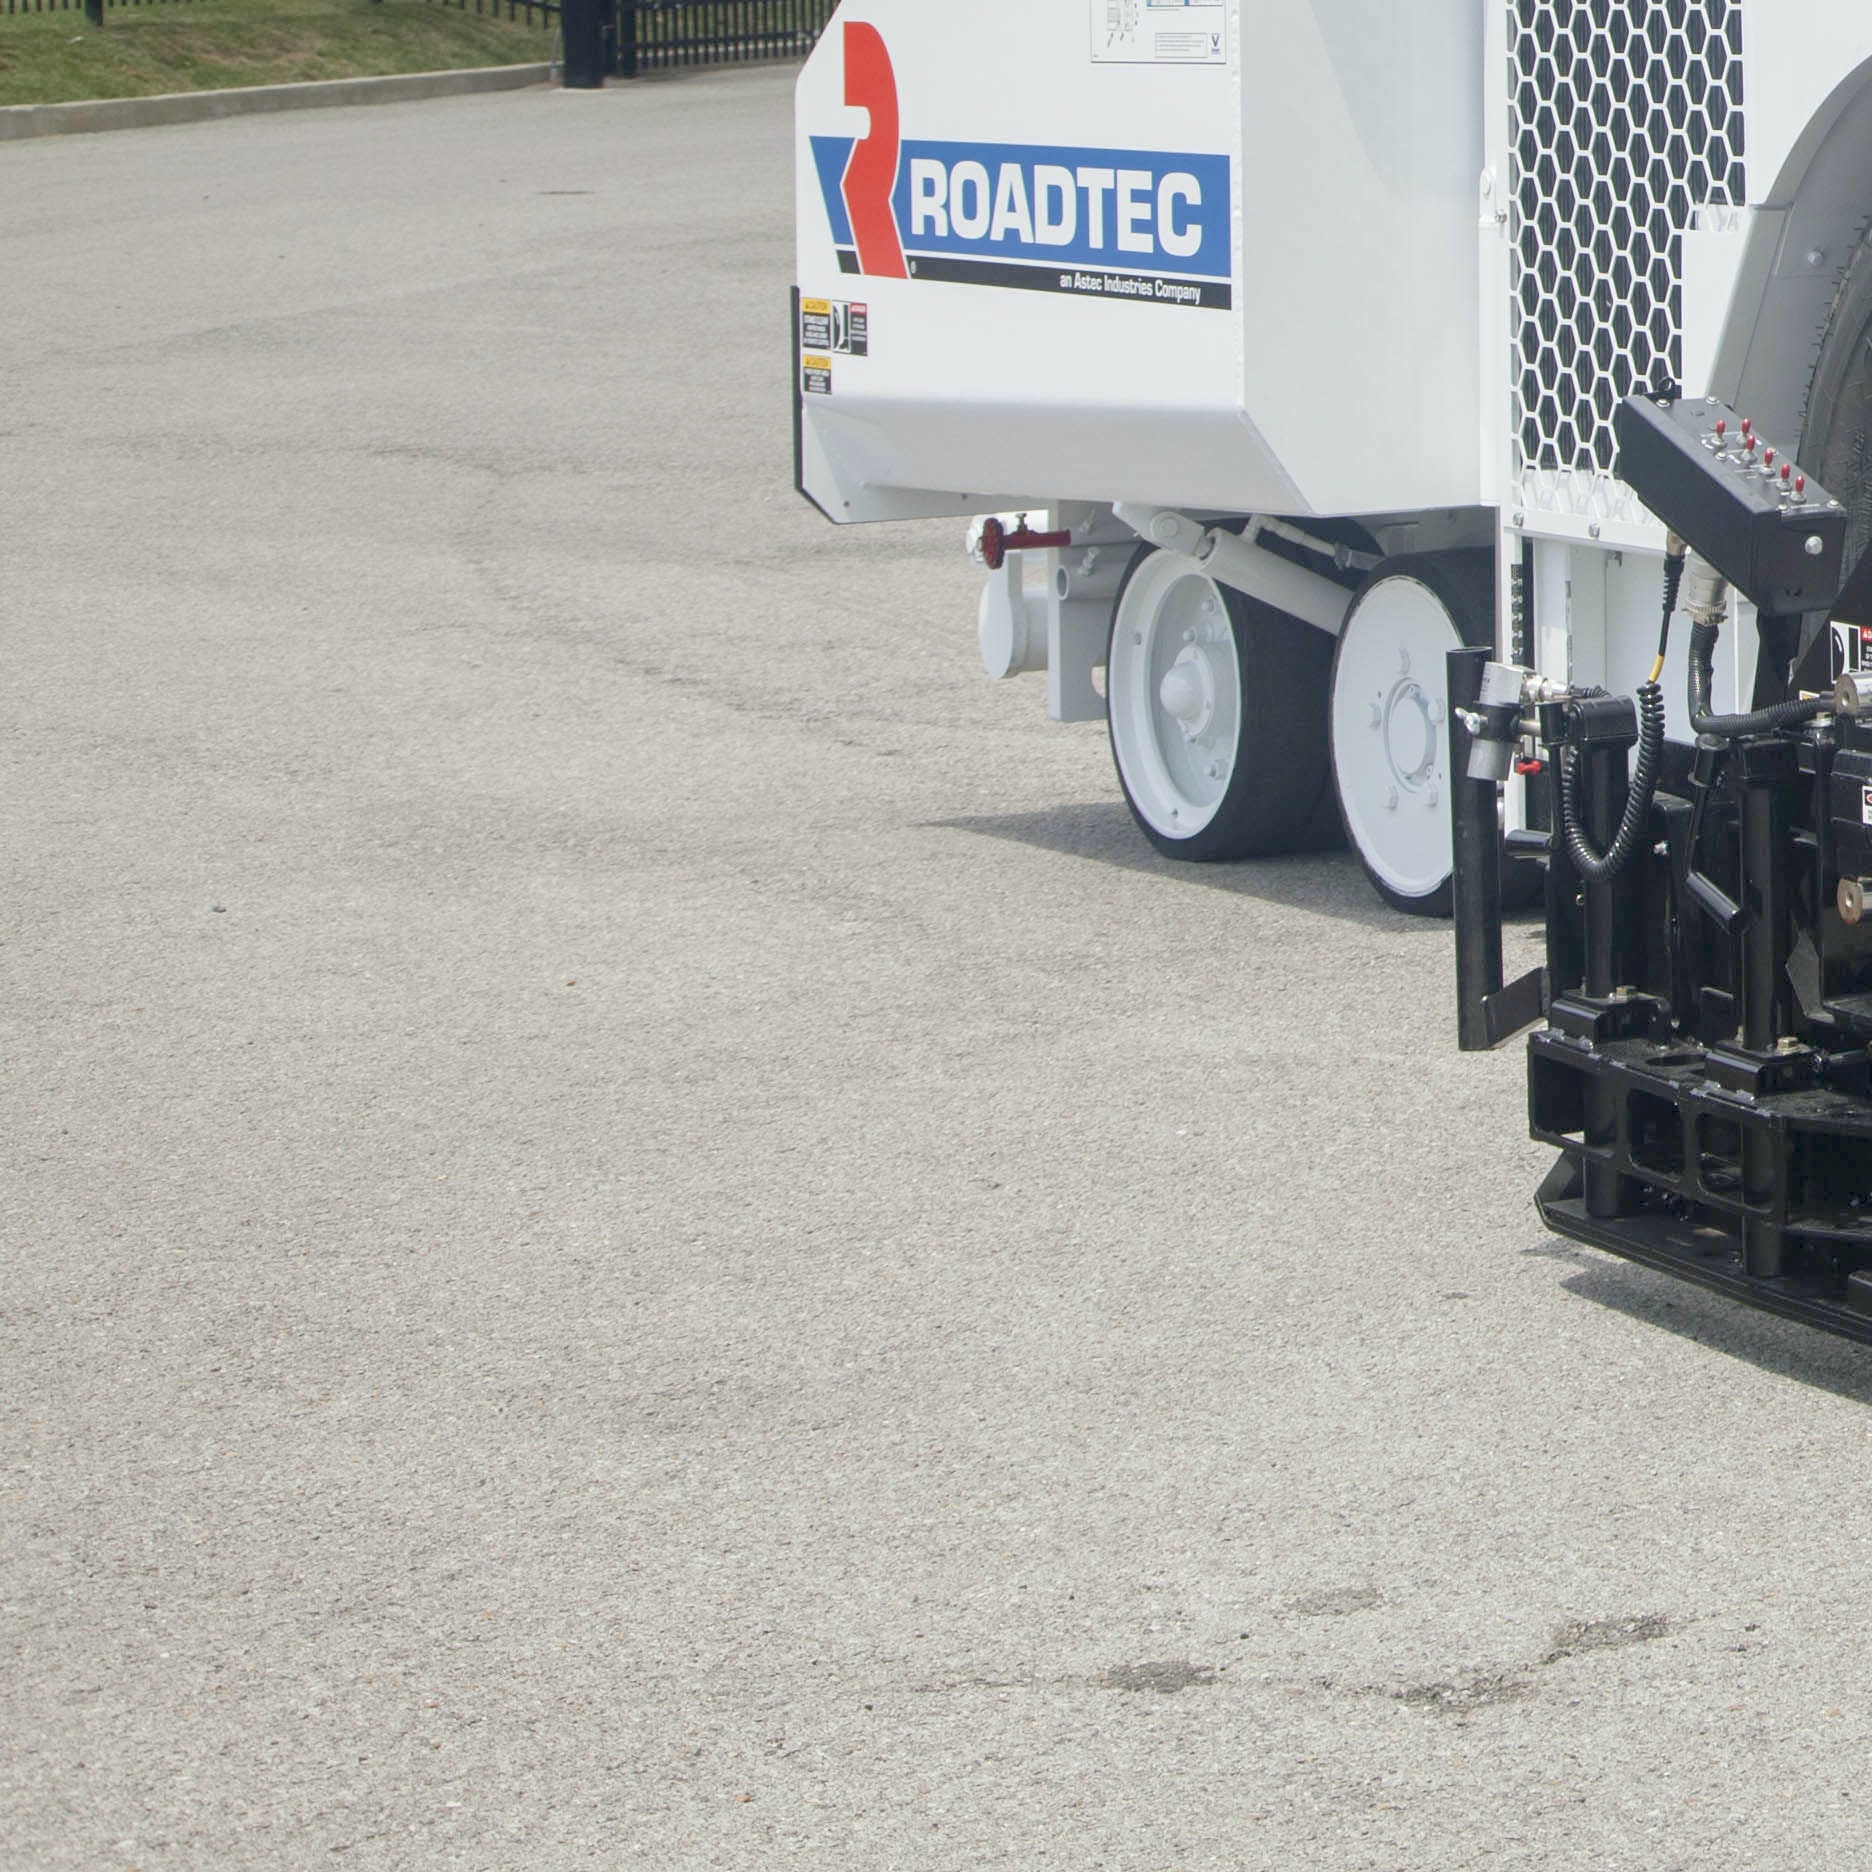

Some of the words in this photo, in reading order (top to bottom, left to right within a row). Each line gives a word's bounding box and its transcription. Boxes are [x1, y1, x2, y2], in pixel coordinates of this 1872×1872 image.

[911, 158, 1202, 257] ROADTEC
[1060, 276, 1072, 289] an
[1073, 272, 1102, 291] Astec
[1104, 275, 1153, 296] Industries
[1155, 279, 1201, 305] Company
